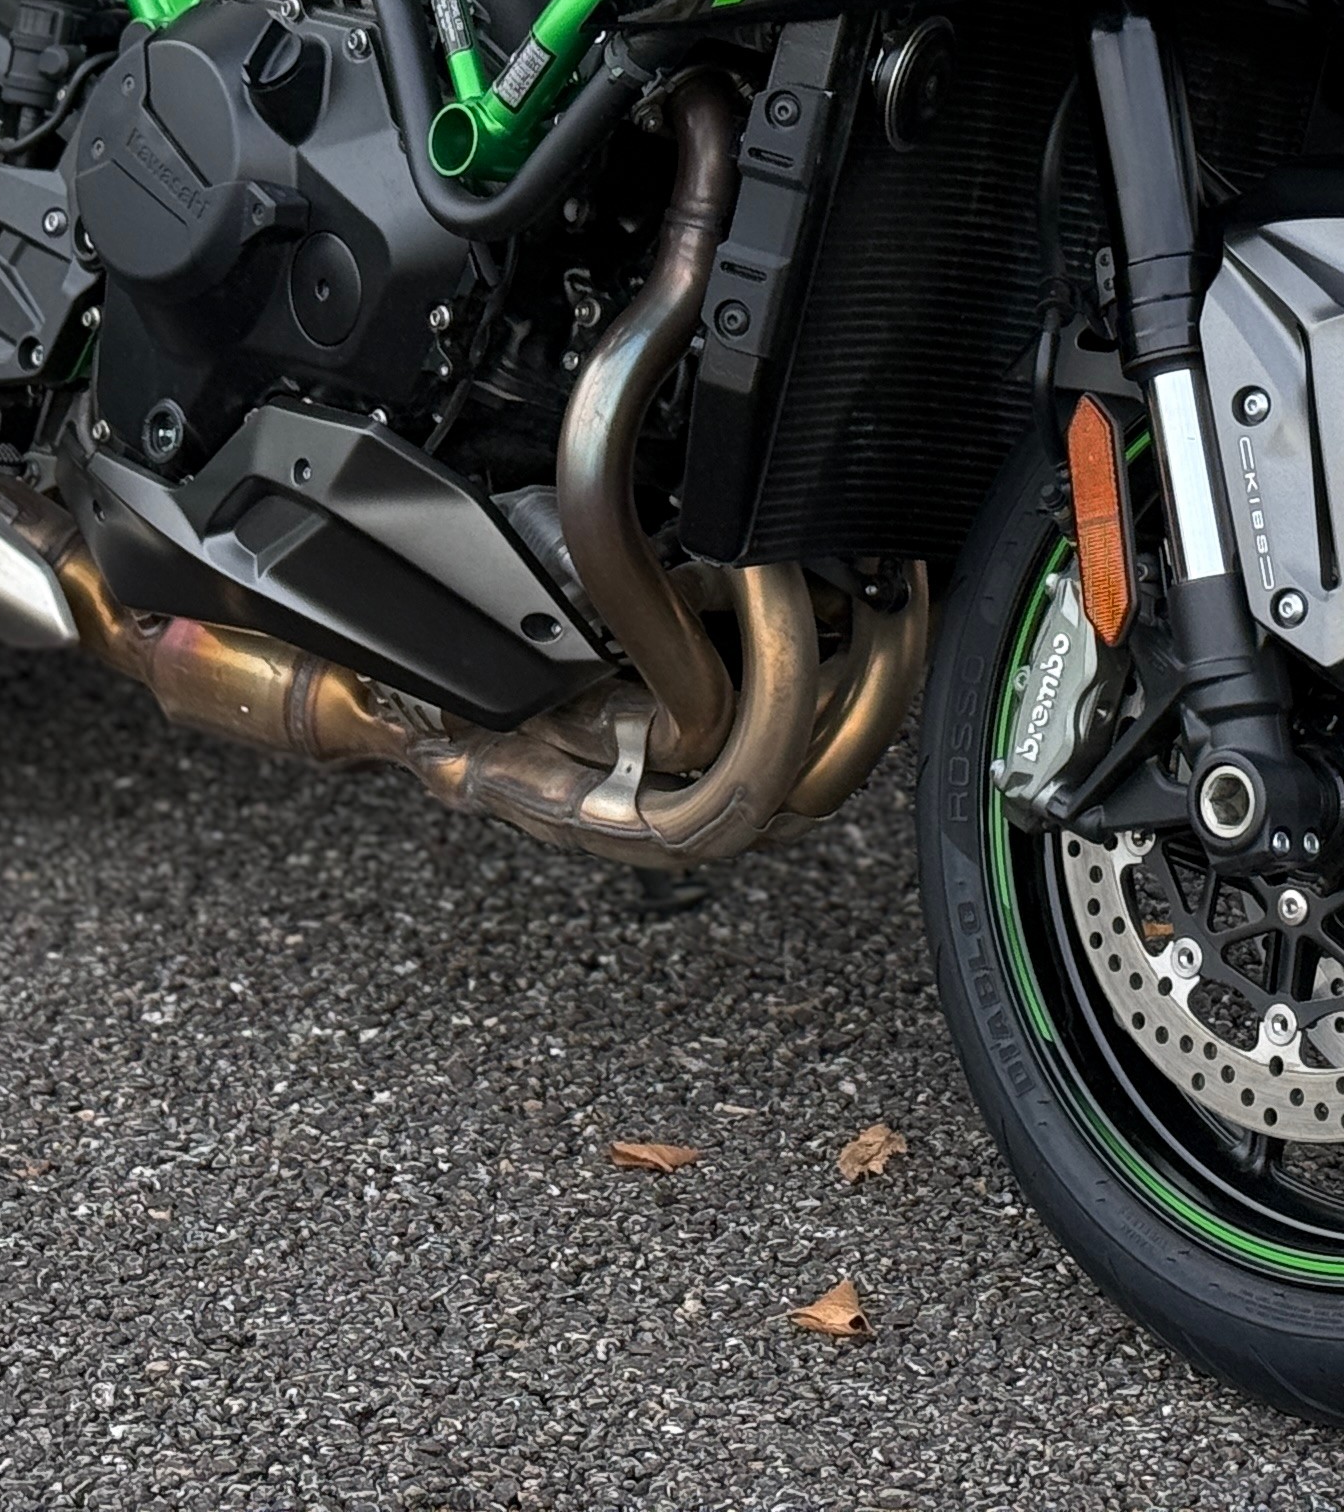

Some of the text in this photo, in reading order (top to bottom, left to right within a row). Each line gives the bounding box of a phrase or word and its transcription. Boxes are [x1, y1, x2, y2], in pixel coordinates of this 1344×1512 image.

[1014, 633, 1070, 762] brembo
[949, 654, 1037, 1098] DIABLO ROSSO
